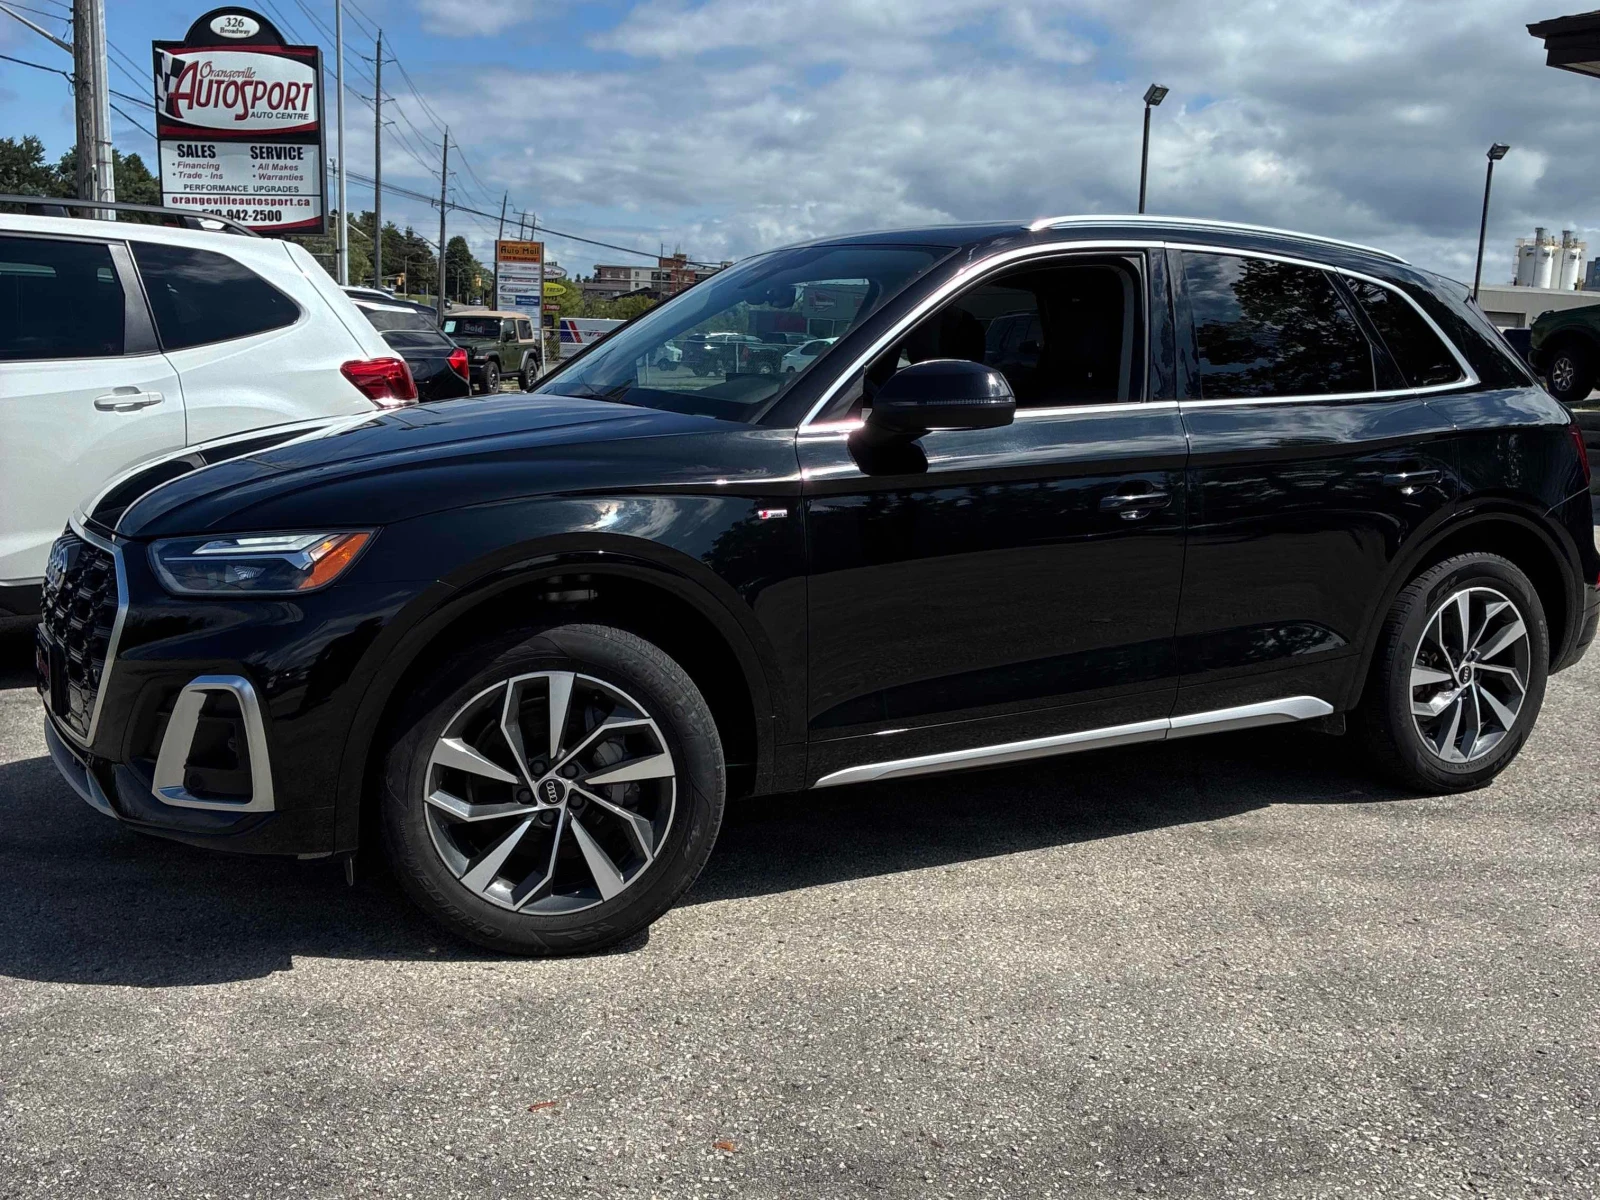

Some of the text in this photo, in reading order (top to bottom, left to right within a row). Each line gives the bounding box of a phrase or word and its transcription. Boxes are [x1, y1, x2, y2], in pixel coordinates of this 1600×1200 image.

[225, 17, 245, 28] 326
[219, 26, 251, 36] Broadway
[200, 61, 256, 82] Orangeville
[250, 111, 309, 121] AUTO CENTRE
[177, 144, 217, 159] SALES
[250, 145, 304, 160] SERVICE
[177, 161, 220, 171] Financing
[257, 163, 299, 171] All Makes
[258, 173, 304, 181] Warranties
[183, 183, 299, 193] PERFORMANCE UPGRADES
[171, 195, 311, 207] orangevilleautosport.ca
[202, 209, 282, 222] 9-942-2500
[500, 246, 539, 255] Auto Mall
[464, 323, 483, 333] Sold
